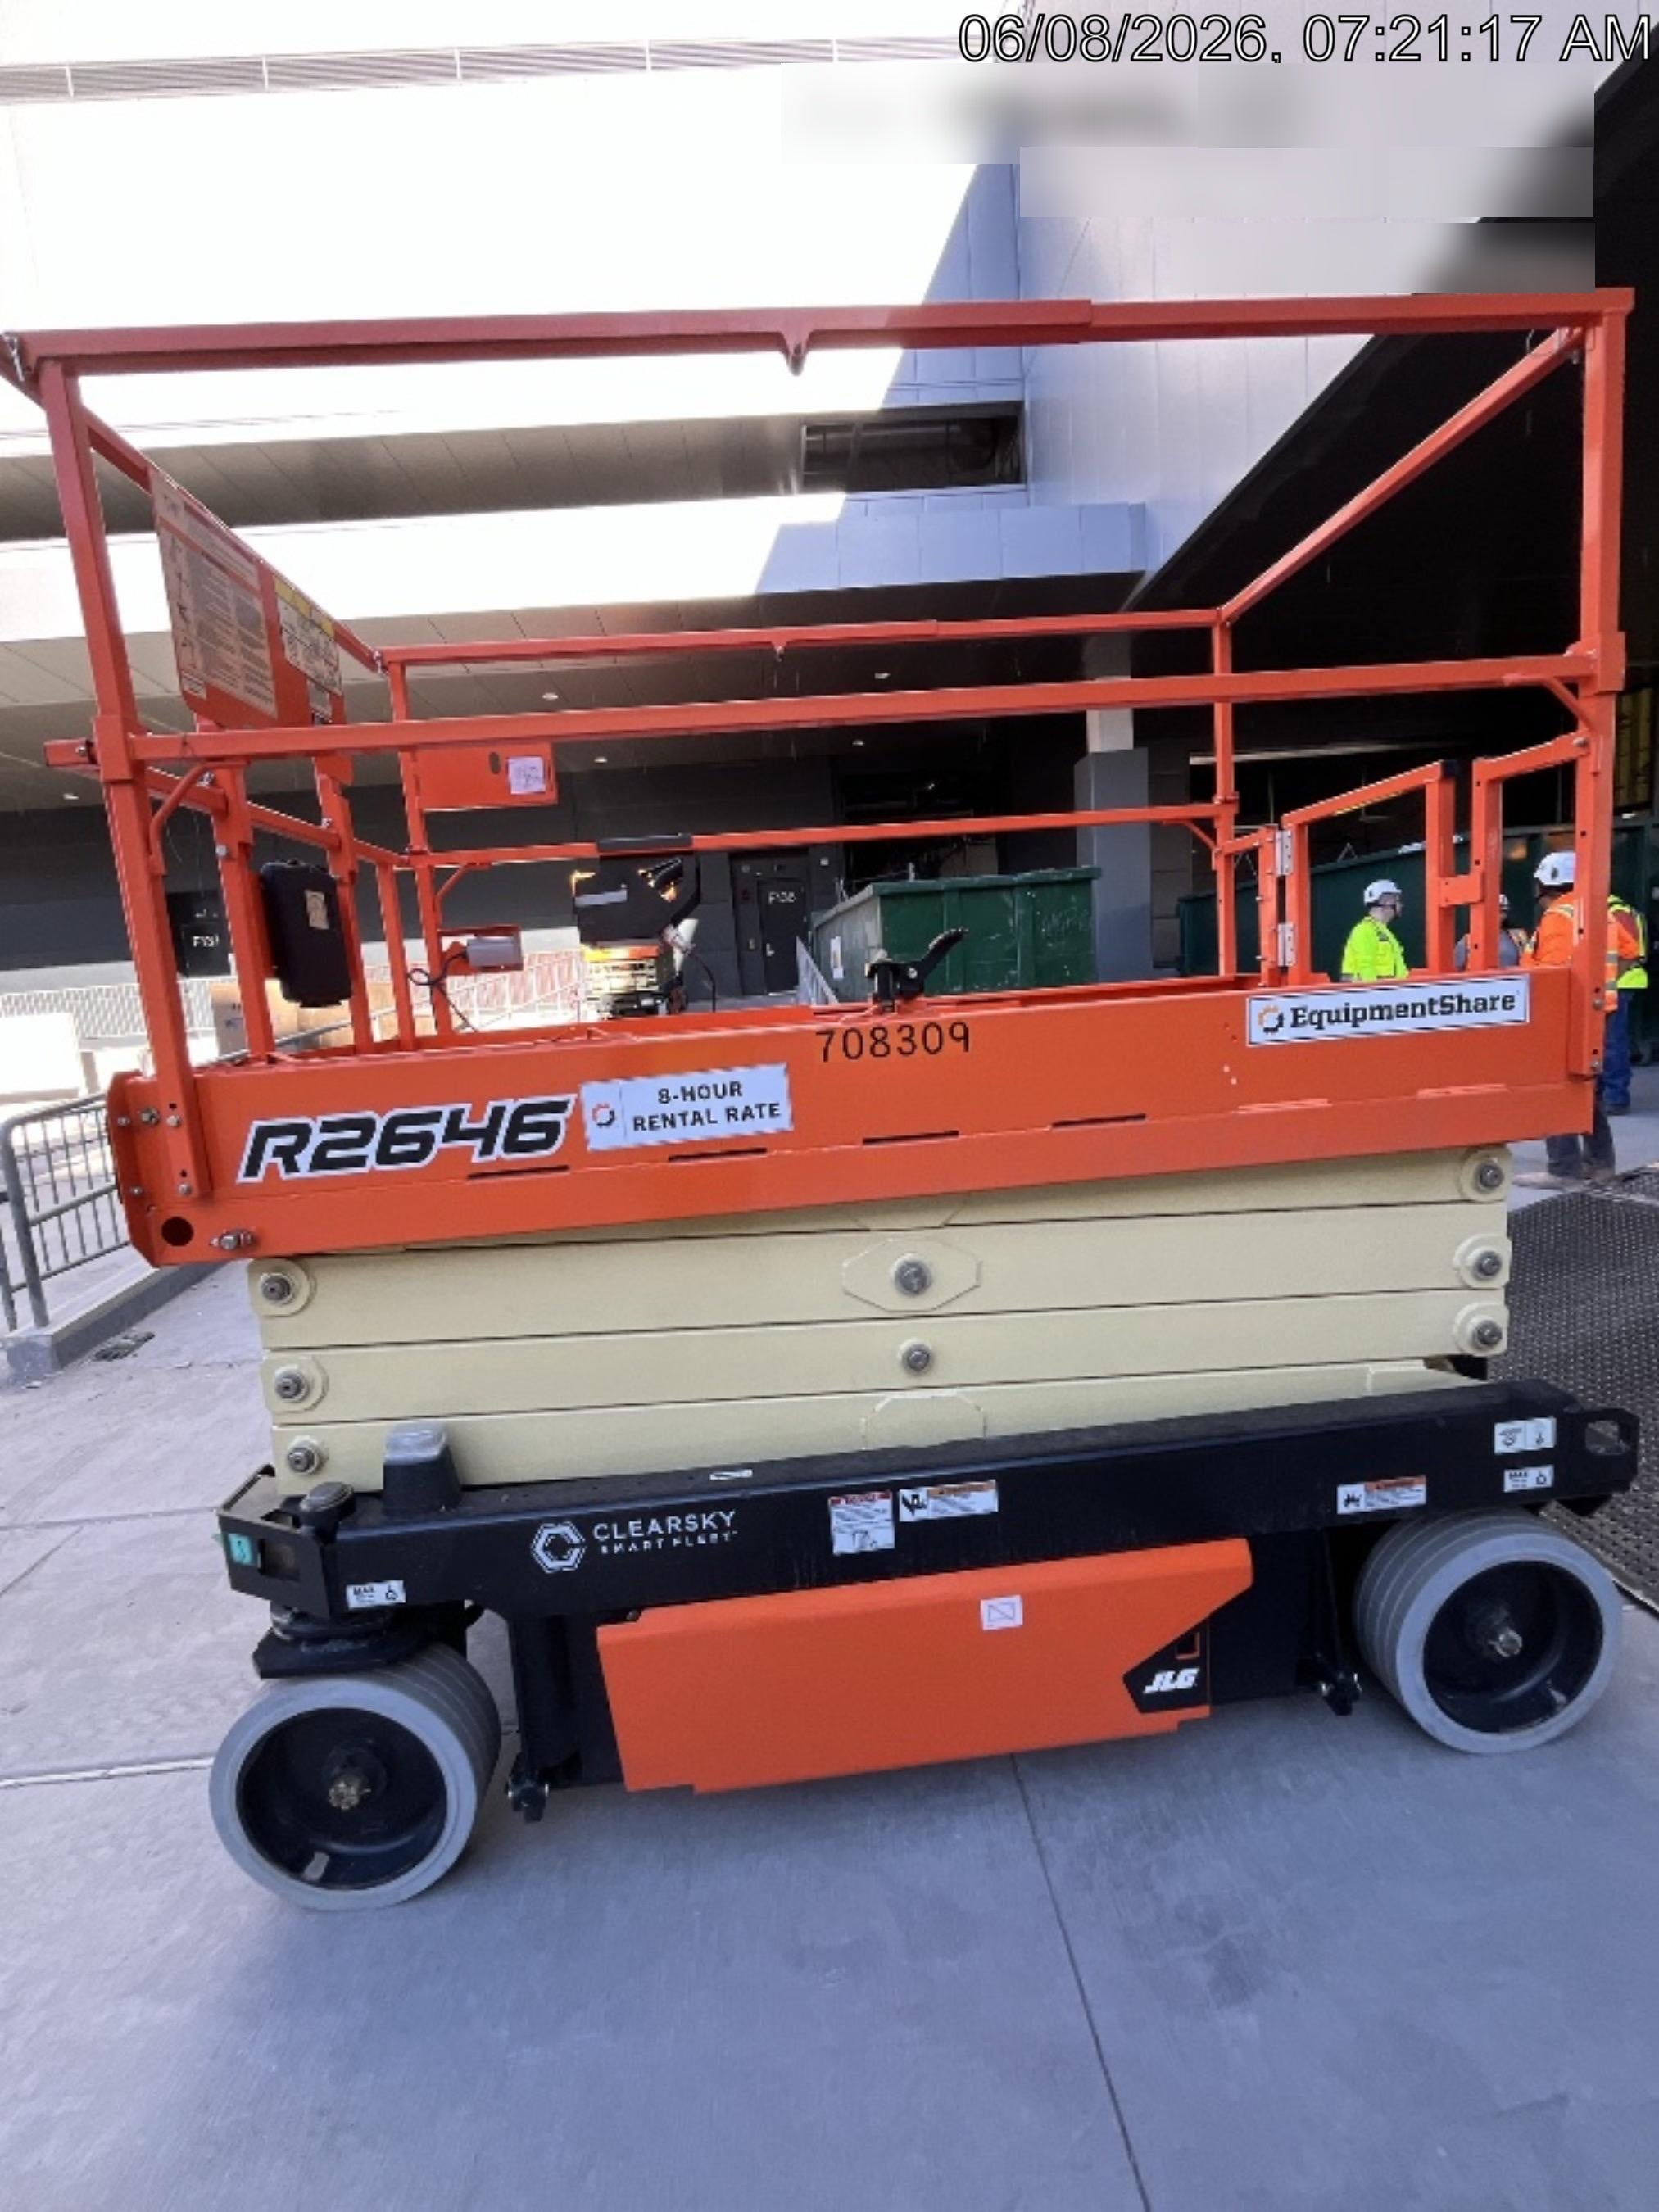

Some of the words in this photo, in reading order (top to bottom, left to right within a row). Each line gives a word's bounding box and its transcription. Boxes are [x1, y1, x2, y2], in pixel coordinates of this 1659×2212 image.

[1290, 993, 1516, 1029] EquipmentShare
[816, 1022, 969, 1062] 708309
[658, 1081, 742, 1104] 8-HOUR
[633, 1108, 718, 1131] RENTAL
[726, 1103, 781, 1122] RATE
[237, 1095, 576, 1182] R2646
[593, 1511, 736, 1541] CLEARSKY
[1144, 1668, 1199, 1693] JLG
